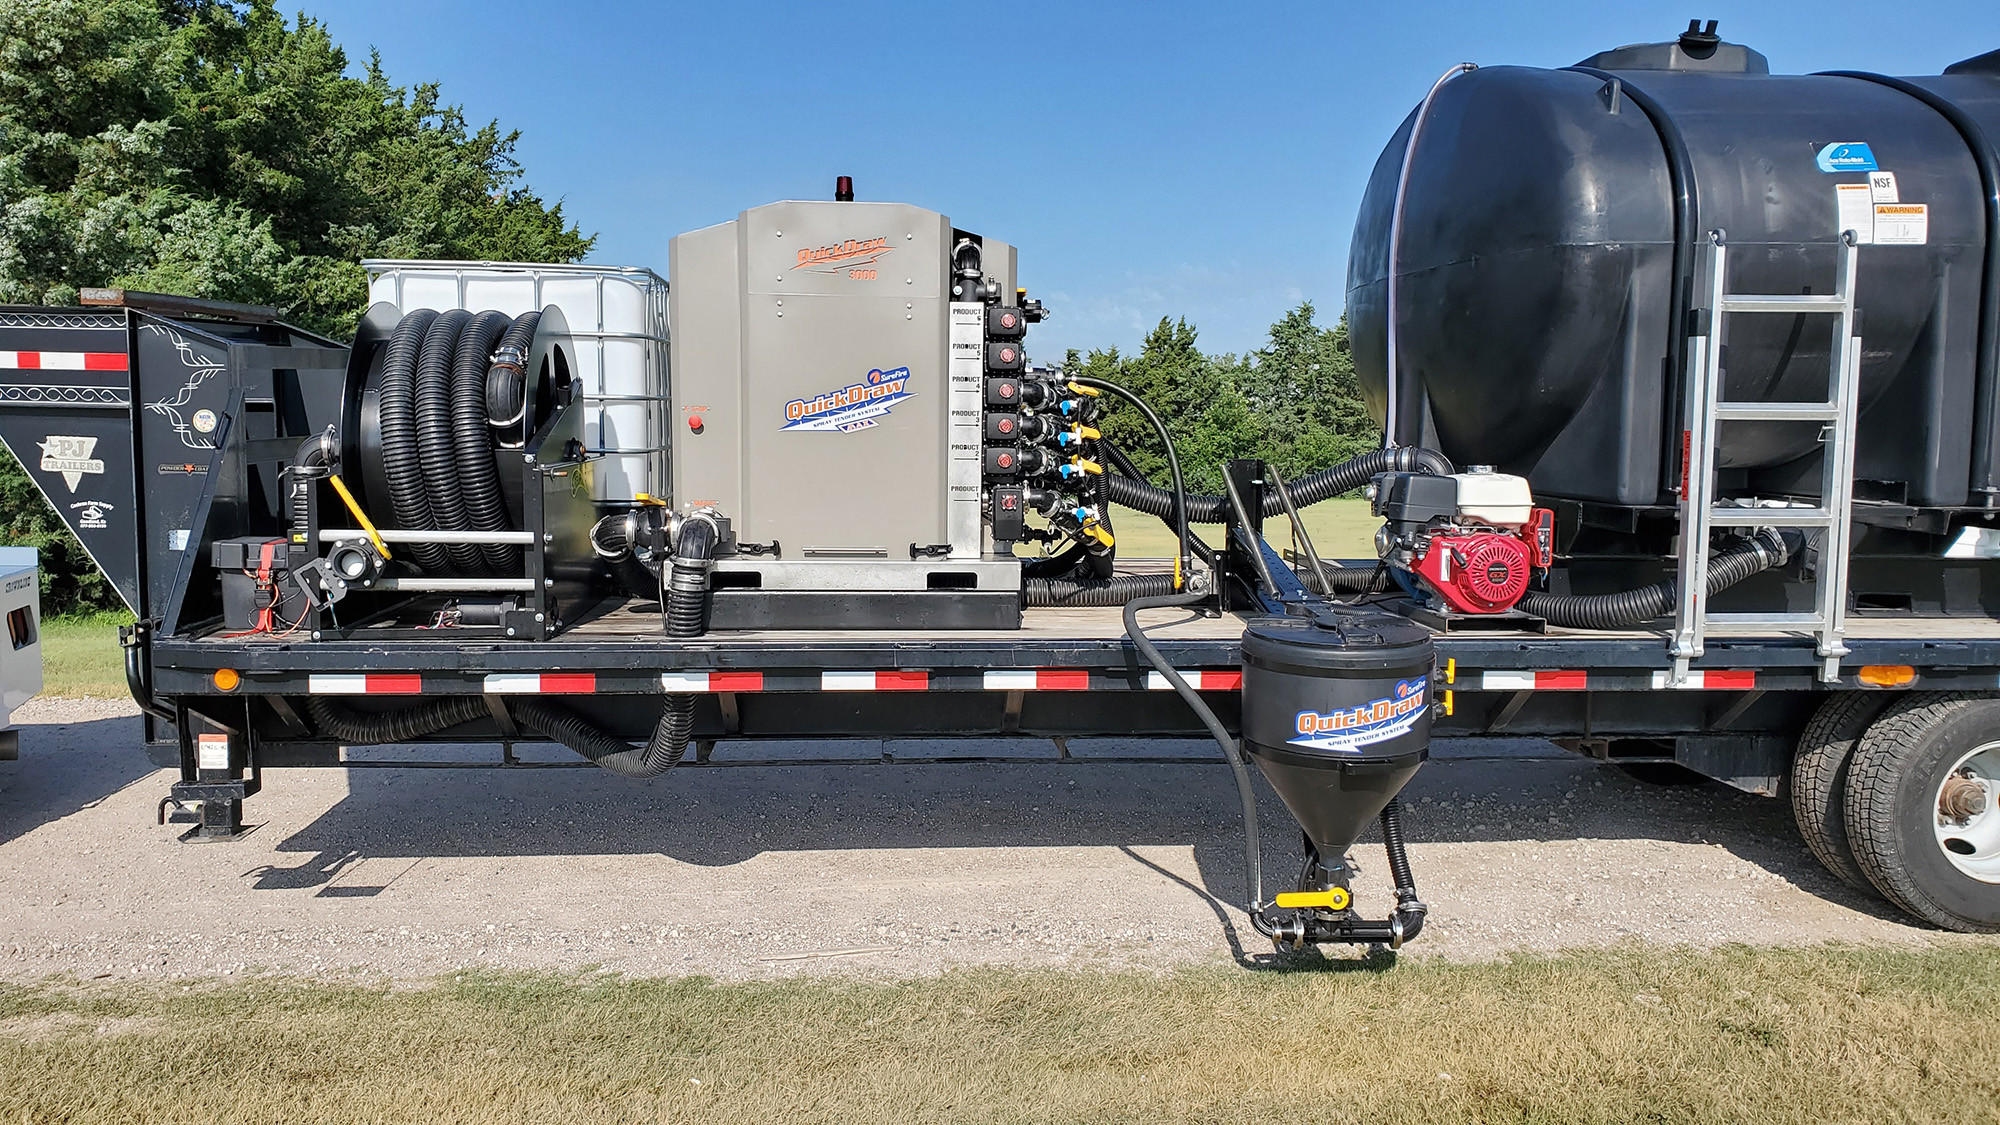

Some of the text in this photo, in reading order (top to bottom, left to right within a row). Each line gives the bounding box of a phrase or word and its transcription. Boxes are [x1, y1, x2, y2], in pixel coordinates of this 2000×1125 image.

[1873, 178, 1891, 188] NSF
[797, 236, 887, 263] QuickDraw
[848, 269, 878, 281] 3000
[880, 370, 908, 382] SureFire
[787, 380, 903, 420] QuickDraw
[813, 406, 881, 428] SPRAY TENDER SYSTEM
[59, 439, 85, 457] PJ
[43, 460, 102, 471] TRAILERS
[1406, 680, 1426, 695] SureFire
[1299, 692, 1424, 733] QuickDraw
[1327, 725, 1405, 747] SPRAY TENDER SYSTEM
